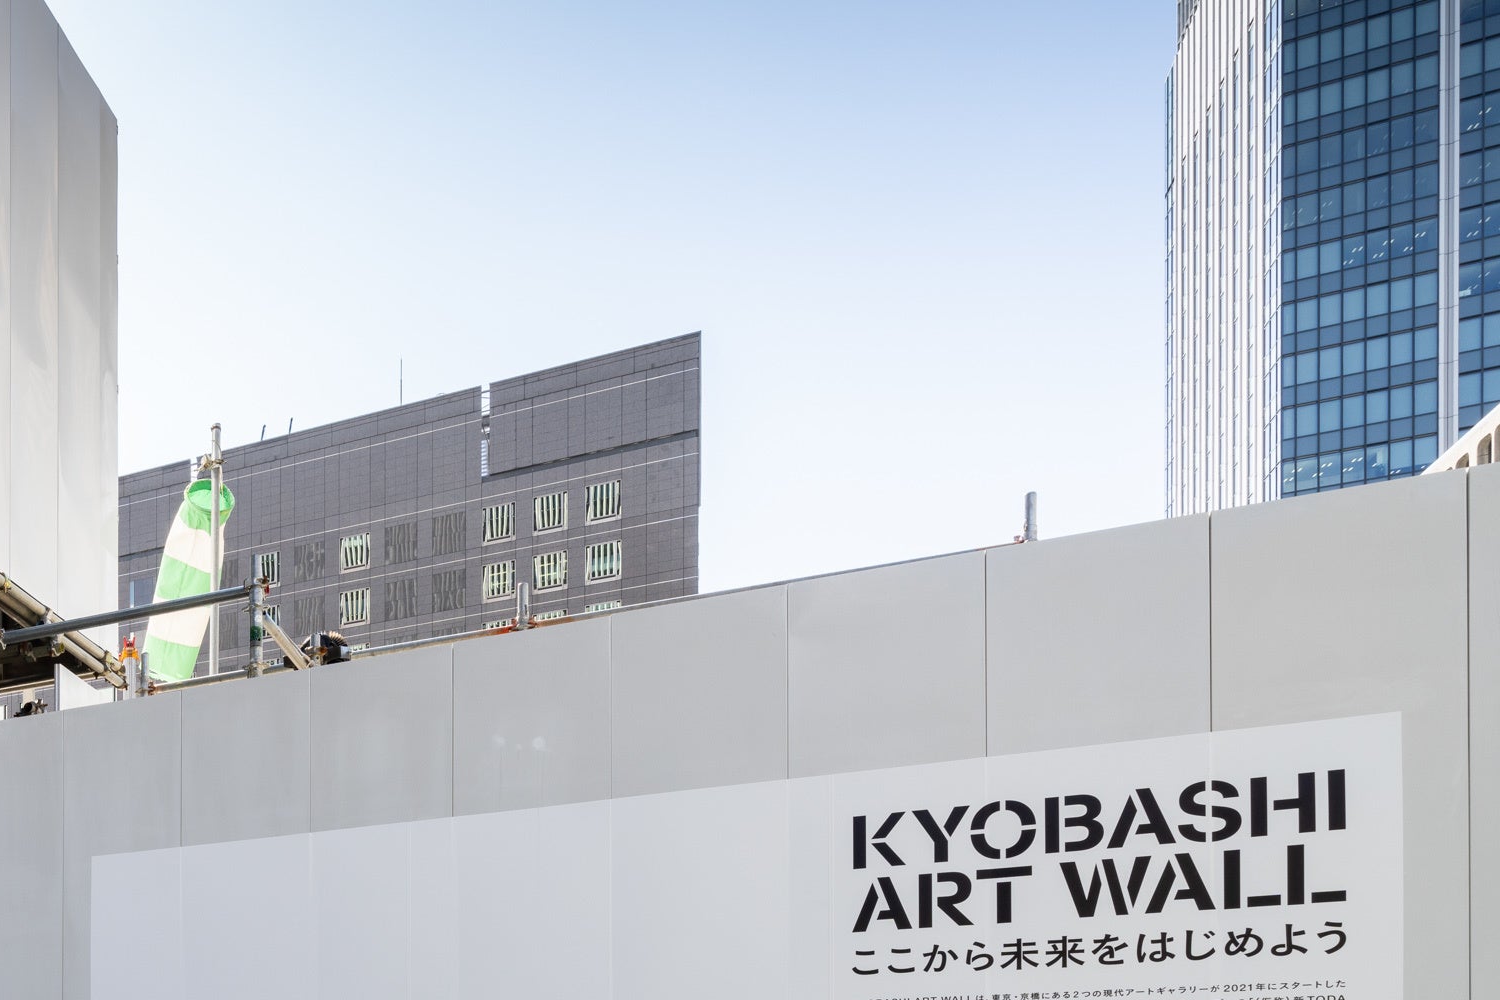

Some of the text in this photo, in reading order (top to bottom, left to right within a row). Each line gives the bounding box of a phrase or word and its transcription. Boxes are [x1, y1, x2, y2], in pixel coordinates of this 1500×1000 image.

[852, 769, 1346, 870] KYOBASHI
[851, 844, 1347, 933] ART WALL
[851, 921, 1348, 976] ここから未来をはじめよう
